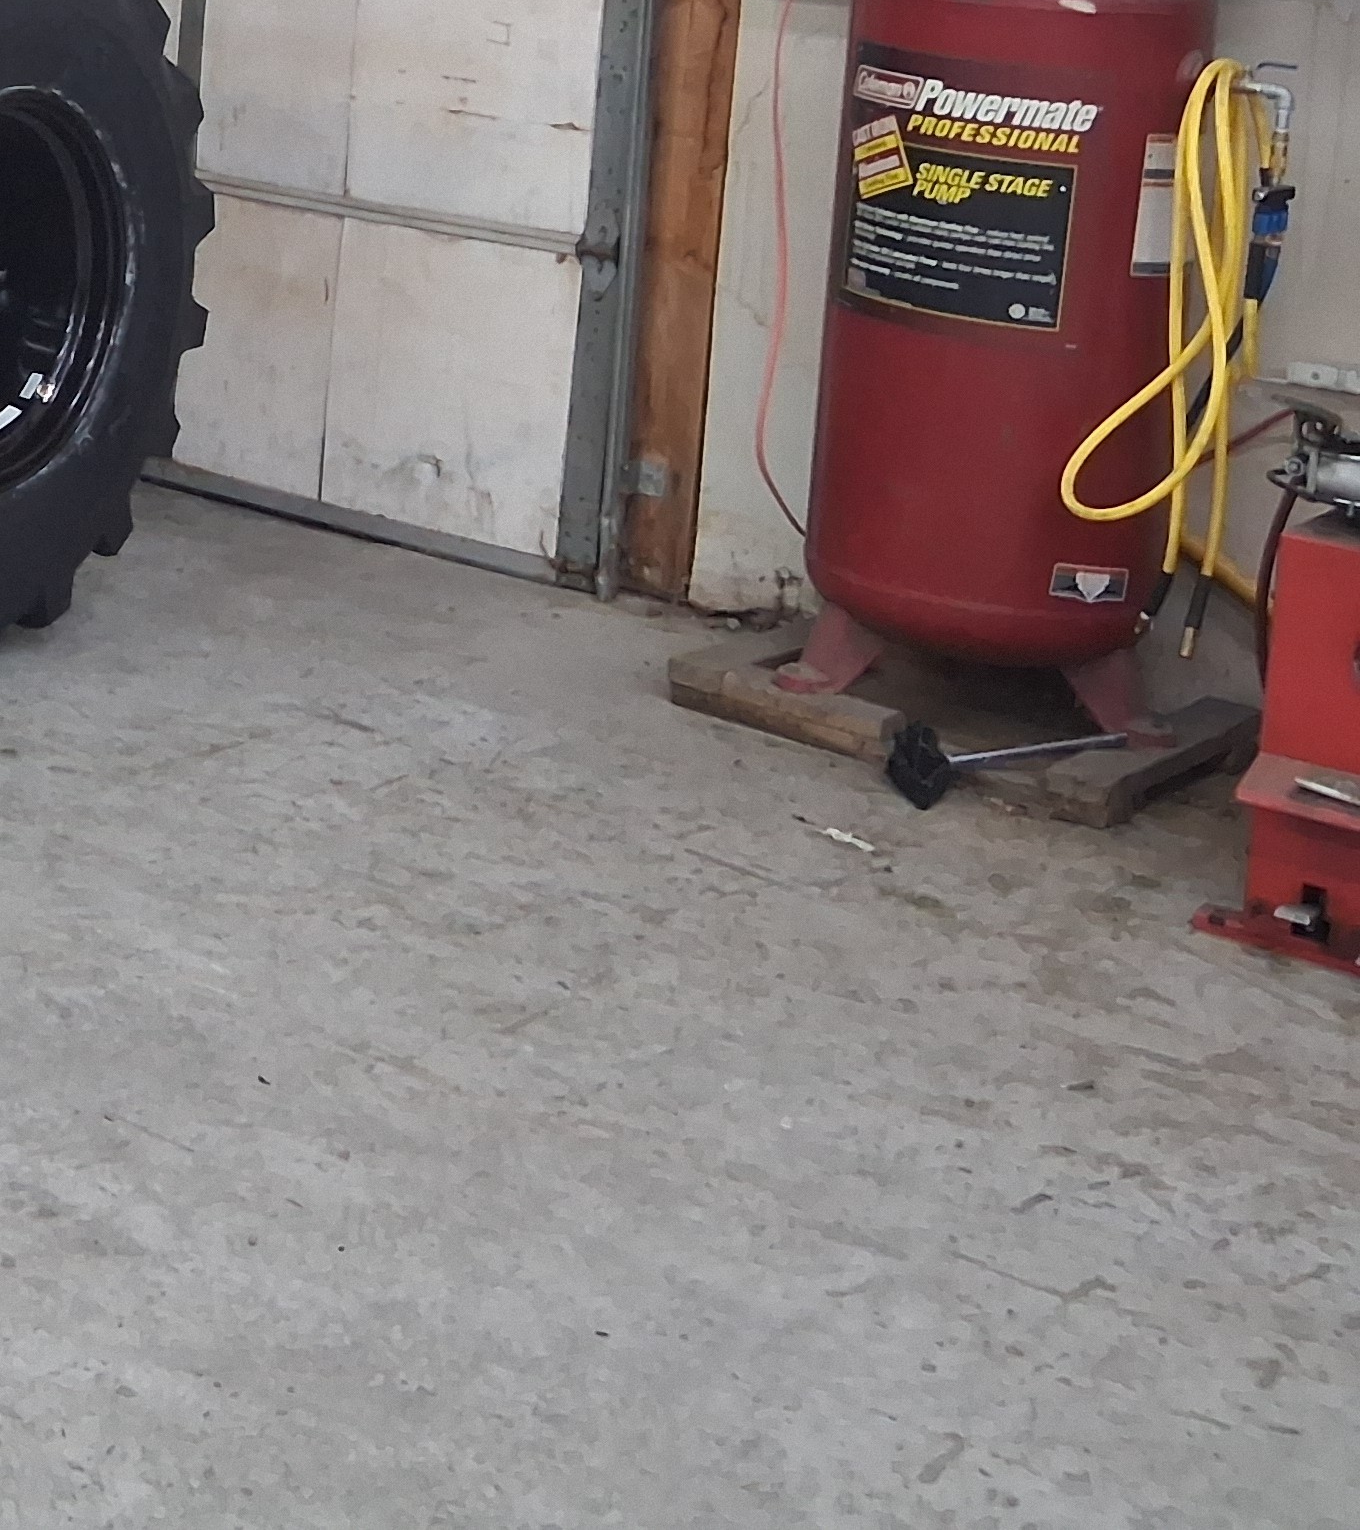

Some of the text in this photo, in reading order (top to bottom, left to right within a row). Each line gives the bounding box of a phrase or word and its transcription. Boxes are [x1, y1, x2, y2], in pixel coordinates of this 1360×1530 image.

[915, 78, 1098, 132] Powermate
[907, 114, 1081, 153] PROFESSIONAL
[912, 181, 972, 204] PUMP
[916, 163, 986, 190] SINGLE
[985, 173, 1053, 198] STAGE
